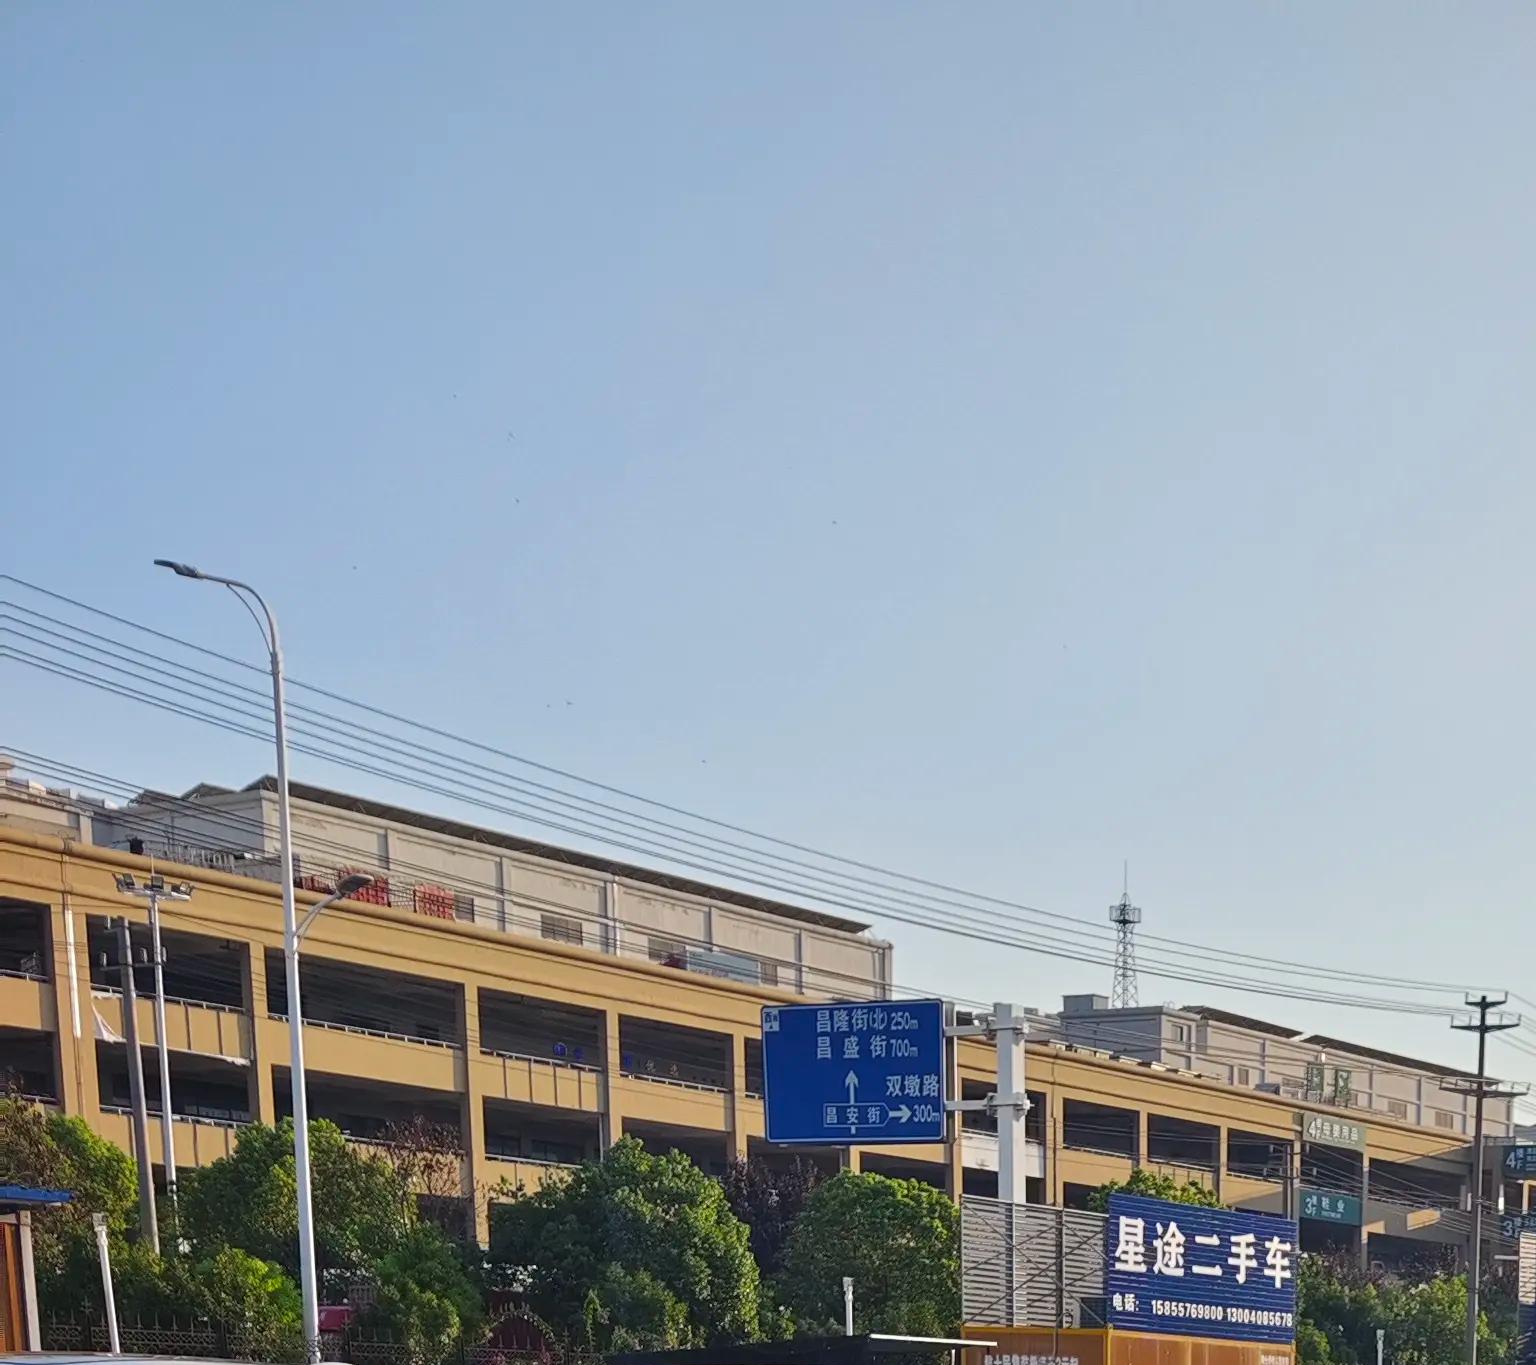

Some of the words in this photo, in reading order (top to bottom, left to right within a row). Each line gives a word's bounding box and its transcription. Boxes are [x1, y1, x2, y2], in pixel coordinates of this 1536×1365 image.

[816, 1008, 888, 1033] 昌隆街(北)
[891, 1012, 919, 1031] 250m
[816, 1035, 887, 1059] 昌盛街
[891, 1039, 918, 1057] 700m
[886, 1075, 940, 1097] 双墩路
[826, 1106, 881, 1123] 昌安街
[912, 1104, 940, 1123] 300m
[1113, 1215, 1293, 1289] 星途二手车
